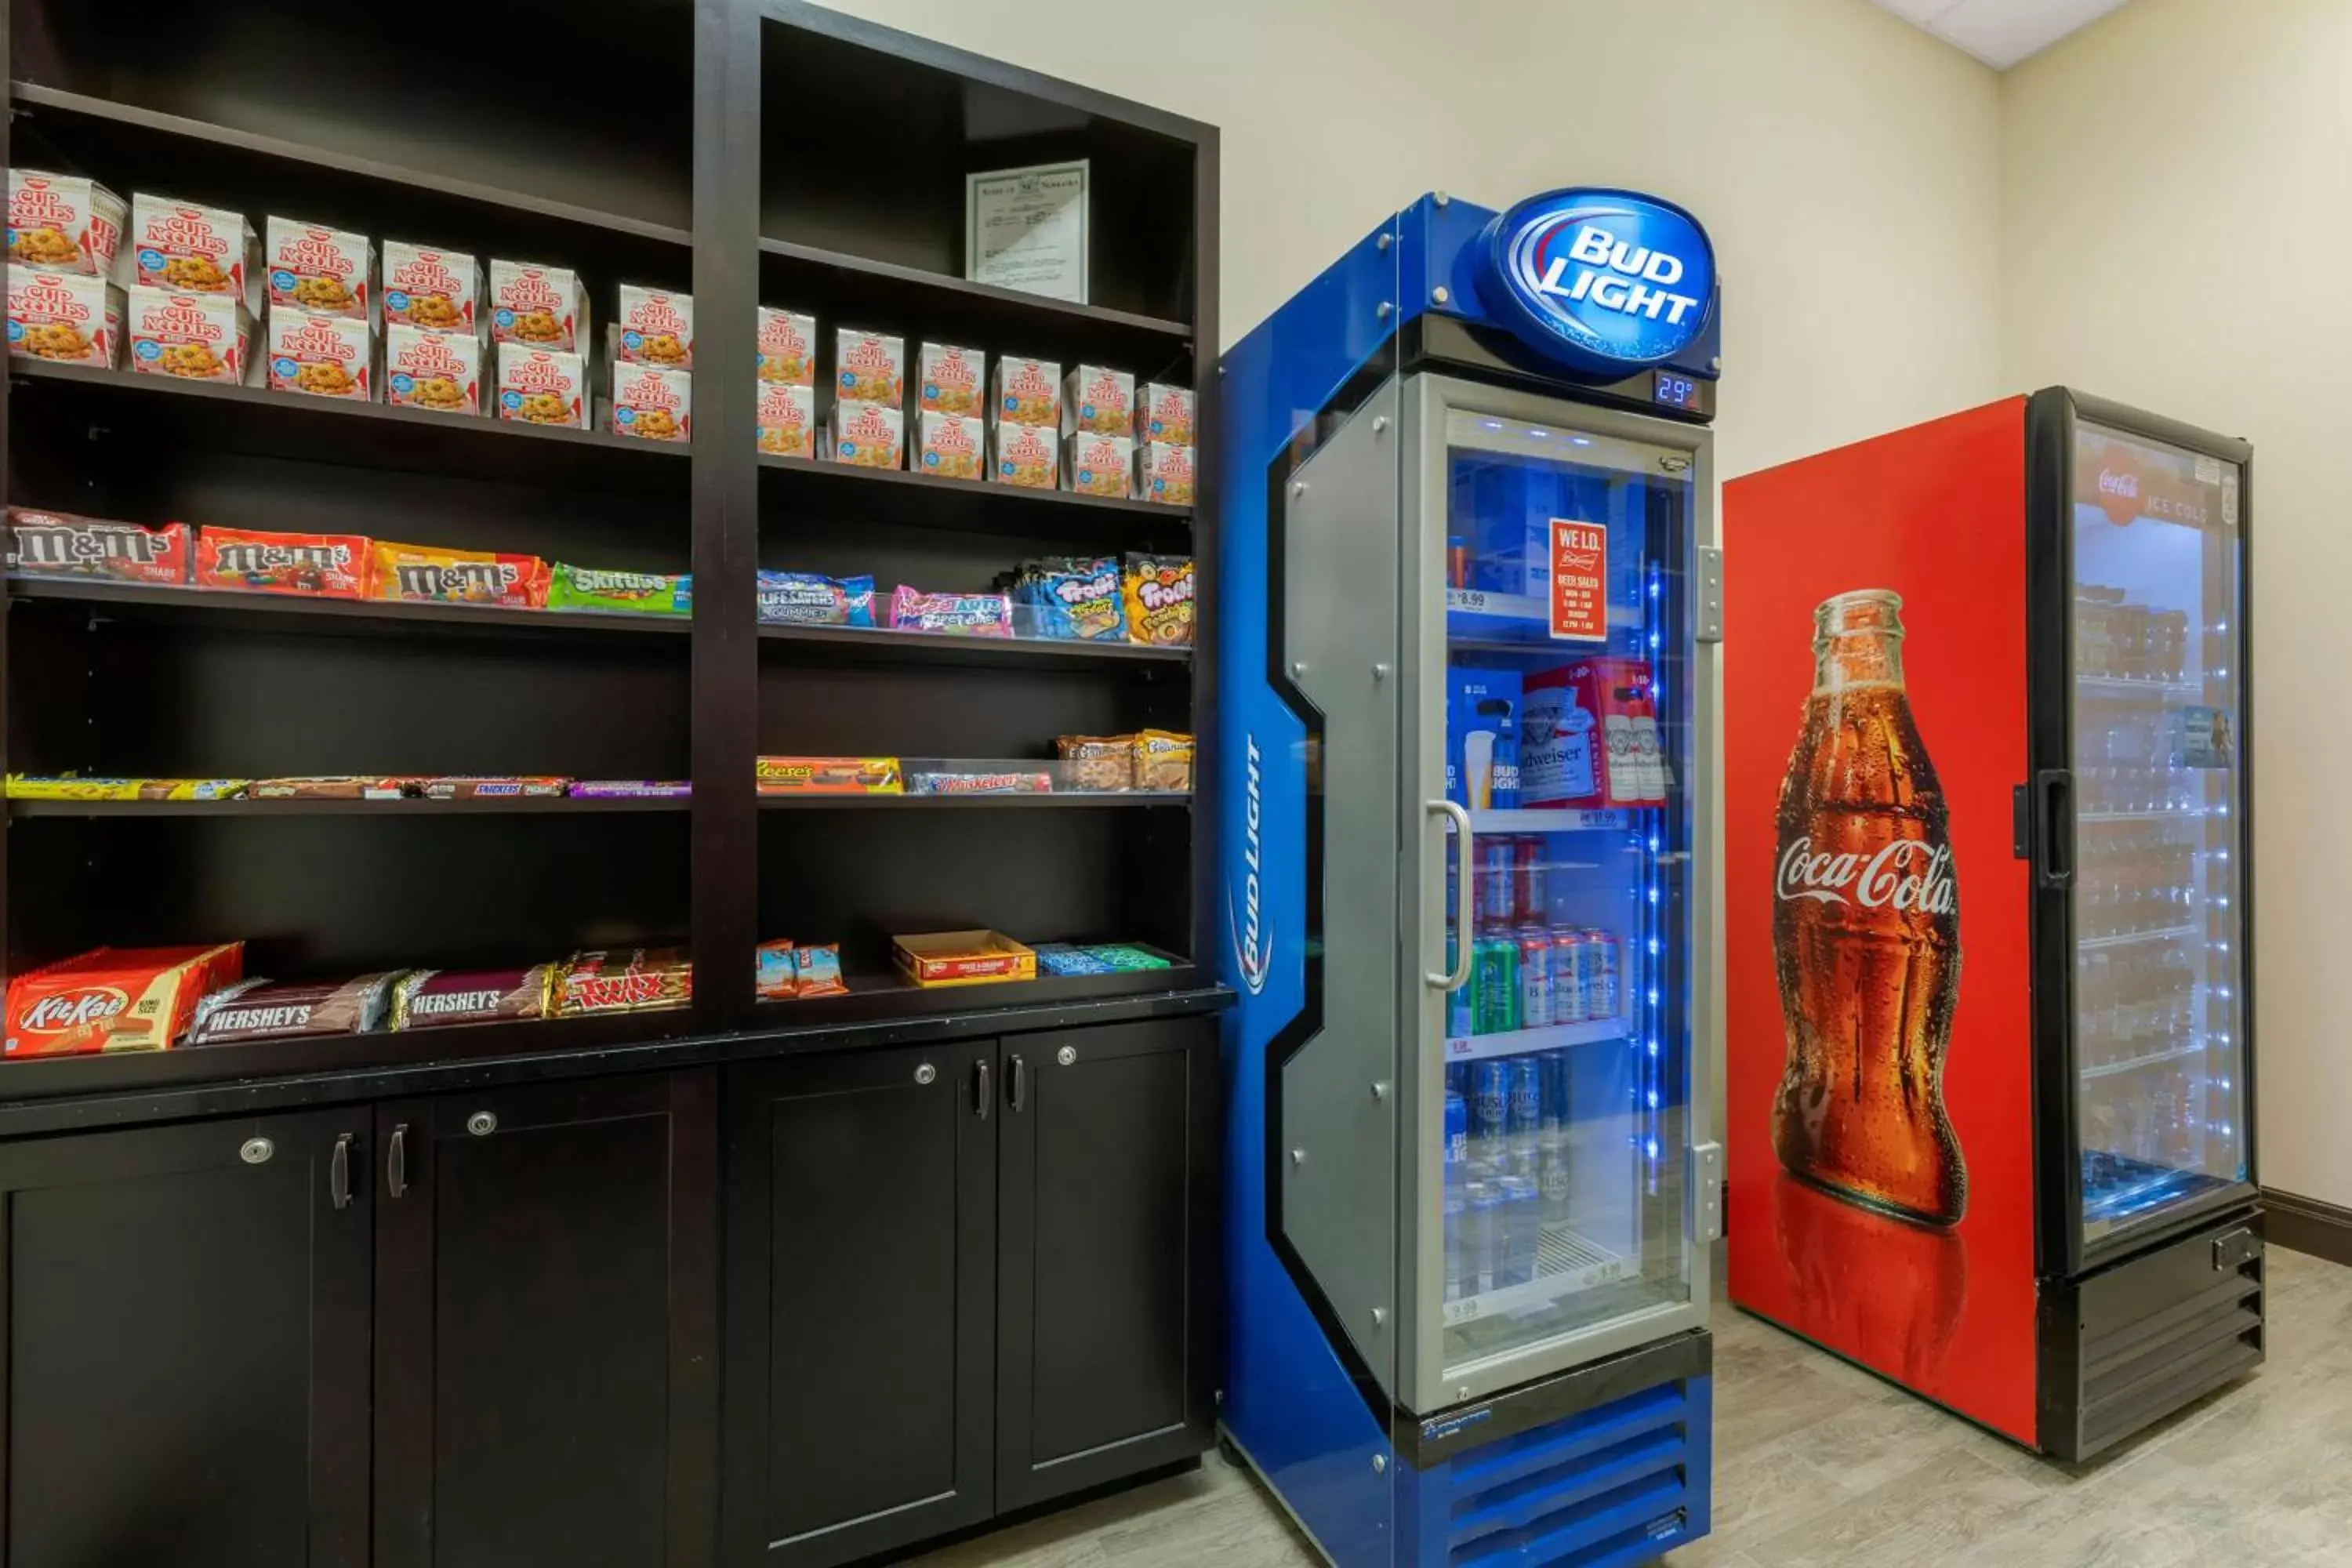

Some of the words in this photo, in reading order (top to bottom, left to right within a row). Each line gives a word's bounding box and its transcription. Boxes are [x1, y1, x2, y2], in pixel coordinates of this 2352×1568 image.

[16, 190, 60, 206] CUP
[166, 217, 212, 235] CUP
[147, 225, 228, 254] NOODLES
[297, 239, 339, 256] CUP
[279, 247, 354, 274] NOODLES
[1570, 226, 1683, 285] BUD
[411, 262, 448, 277] CUP
[392, 269, 463, 292] NOODLES
[516, 278, 550, 292] CUP
[1540, 256, 1697, 325] LIGHT
[27, 285, 73, 303] CUP
[500, 287, 562, 307] NOODLES
[8, 296, 89, 320] NOODLES
[162, 307, 205, 323] CUP
[143, 314, 222, 339] NOODLES
[299, 325, 340, 343] CUP
[281, 335, 354, 359] NOODLES
[415, 344, 453, 358] CUP
[397, 352, 466, 374] NOODLES
[2148, 495, 2169, 514] ICE
[2176, 502, 2208, 523] COLD
[1559, 528, 1580, 548] WE
[1523, 747, 1581, 768] dweiser
[477, 784, 521, 794] SNICKERS
[1245, 734, 1261, 871] LIGHT
[1777, 837, 1956, 915] Coca-Cola
[1244, 874, 1260, 976] BUD
[138, 998, 160, 1008] KING
[138, 1006, 158, 1014] SIZE
[413, 990, 500, 1014] HERSHEY'S
[209, 1004, 311, 1031] HERSHEY'S
